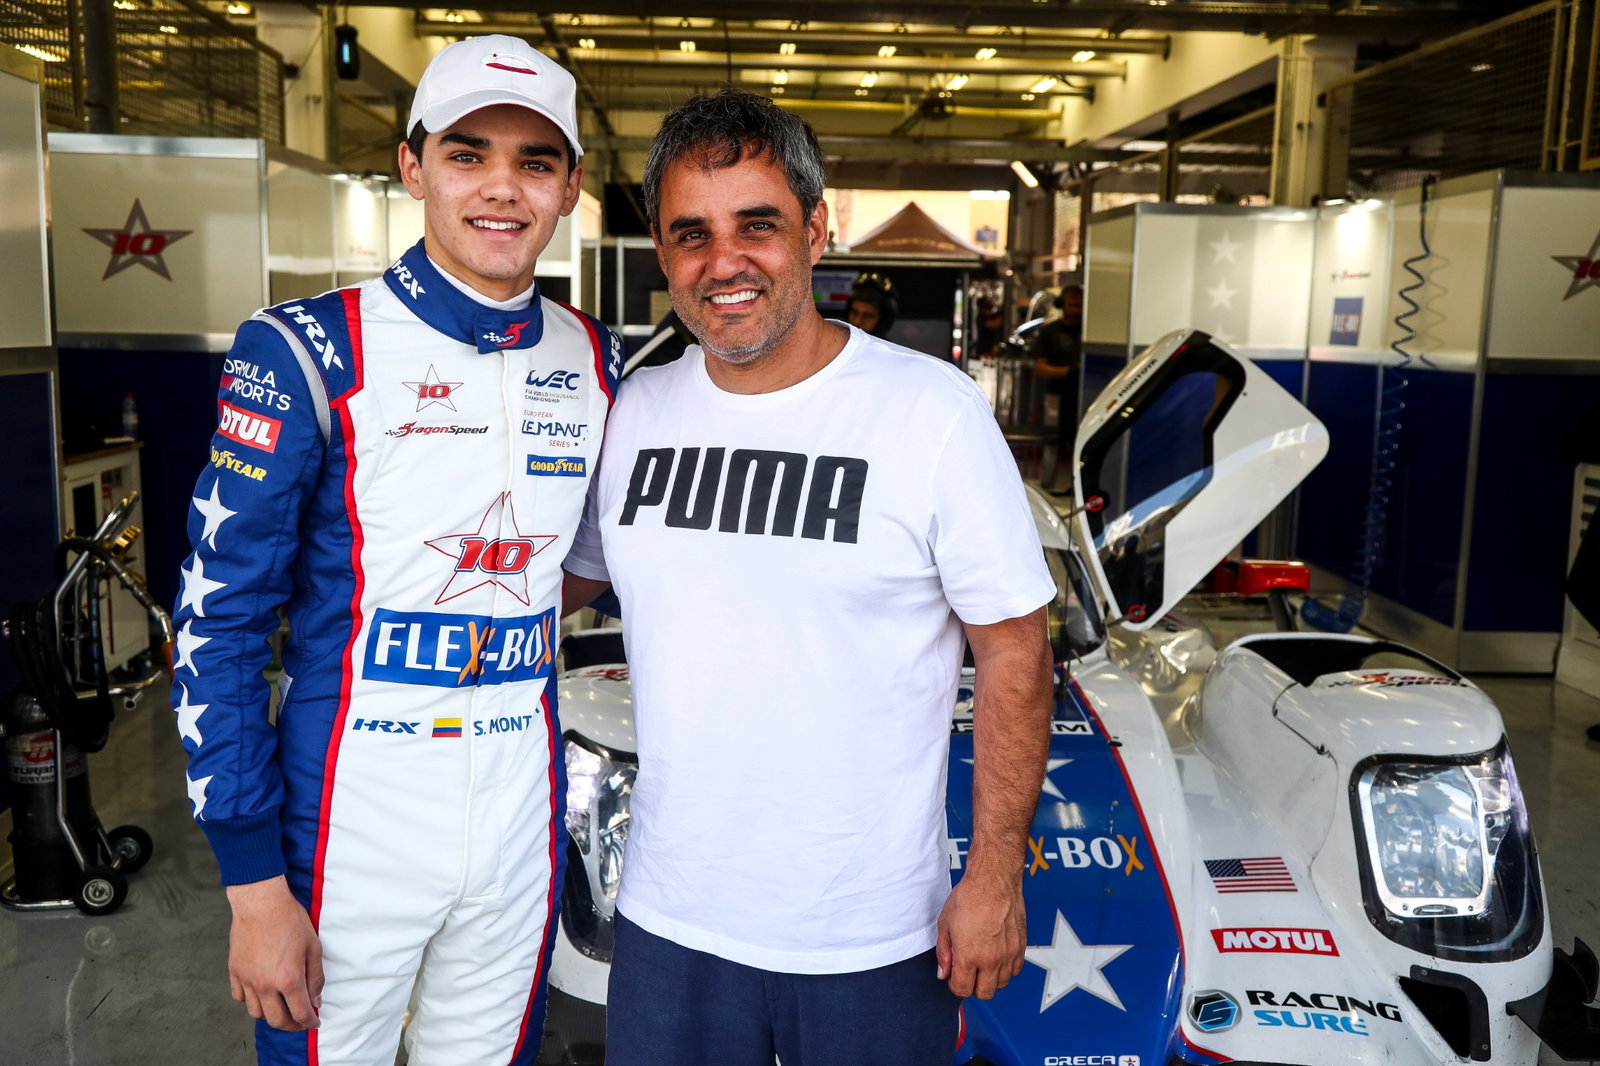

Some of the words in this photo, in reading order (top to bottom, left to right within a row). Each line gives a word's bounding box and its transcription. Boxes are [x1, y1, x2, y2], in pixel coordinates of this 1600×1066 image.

[112, 233, 166, 255] 10
[282, 305, 344, 371] HRX
[607, 326, 622, 380] HR
[223, 358, 276, 388] ORMULA
[525, 370, 580, 391] WEC
[418, 384, 451, 399] 10
[220, 405, 272, 446] OTUL
[523, 409, 554, 418] EUROPEAN
[548, 439, 571, 448] SERIES
[618, 447, 869, 544] PUMA
[454, 537, 534, 575] 10
[352, 718, 421, 735] HRX
[489, 714, 533, 735] MONT
[948, 834, 1145, 877] FX-BOX
[1222, 930, 1332, 952] MOTUL
[1246, 990, 1403, 1022] RACING
[1254, 1010, 1369, 1036] SURE
[1044, 1055, 1116, 1066] ORECA
